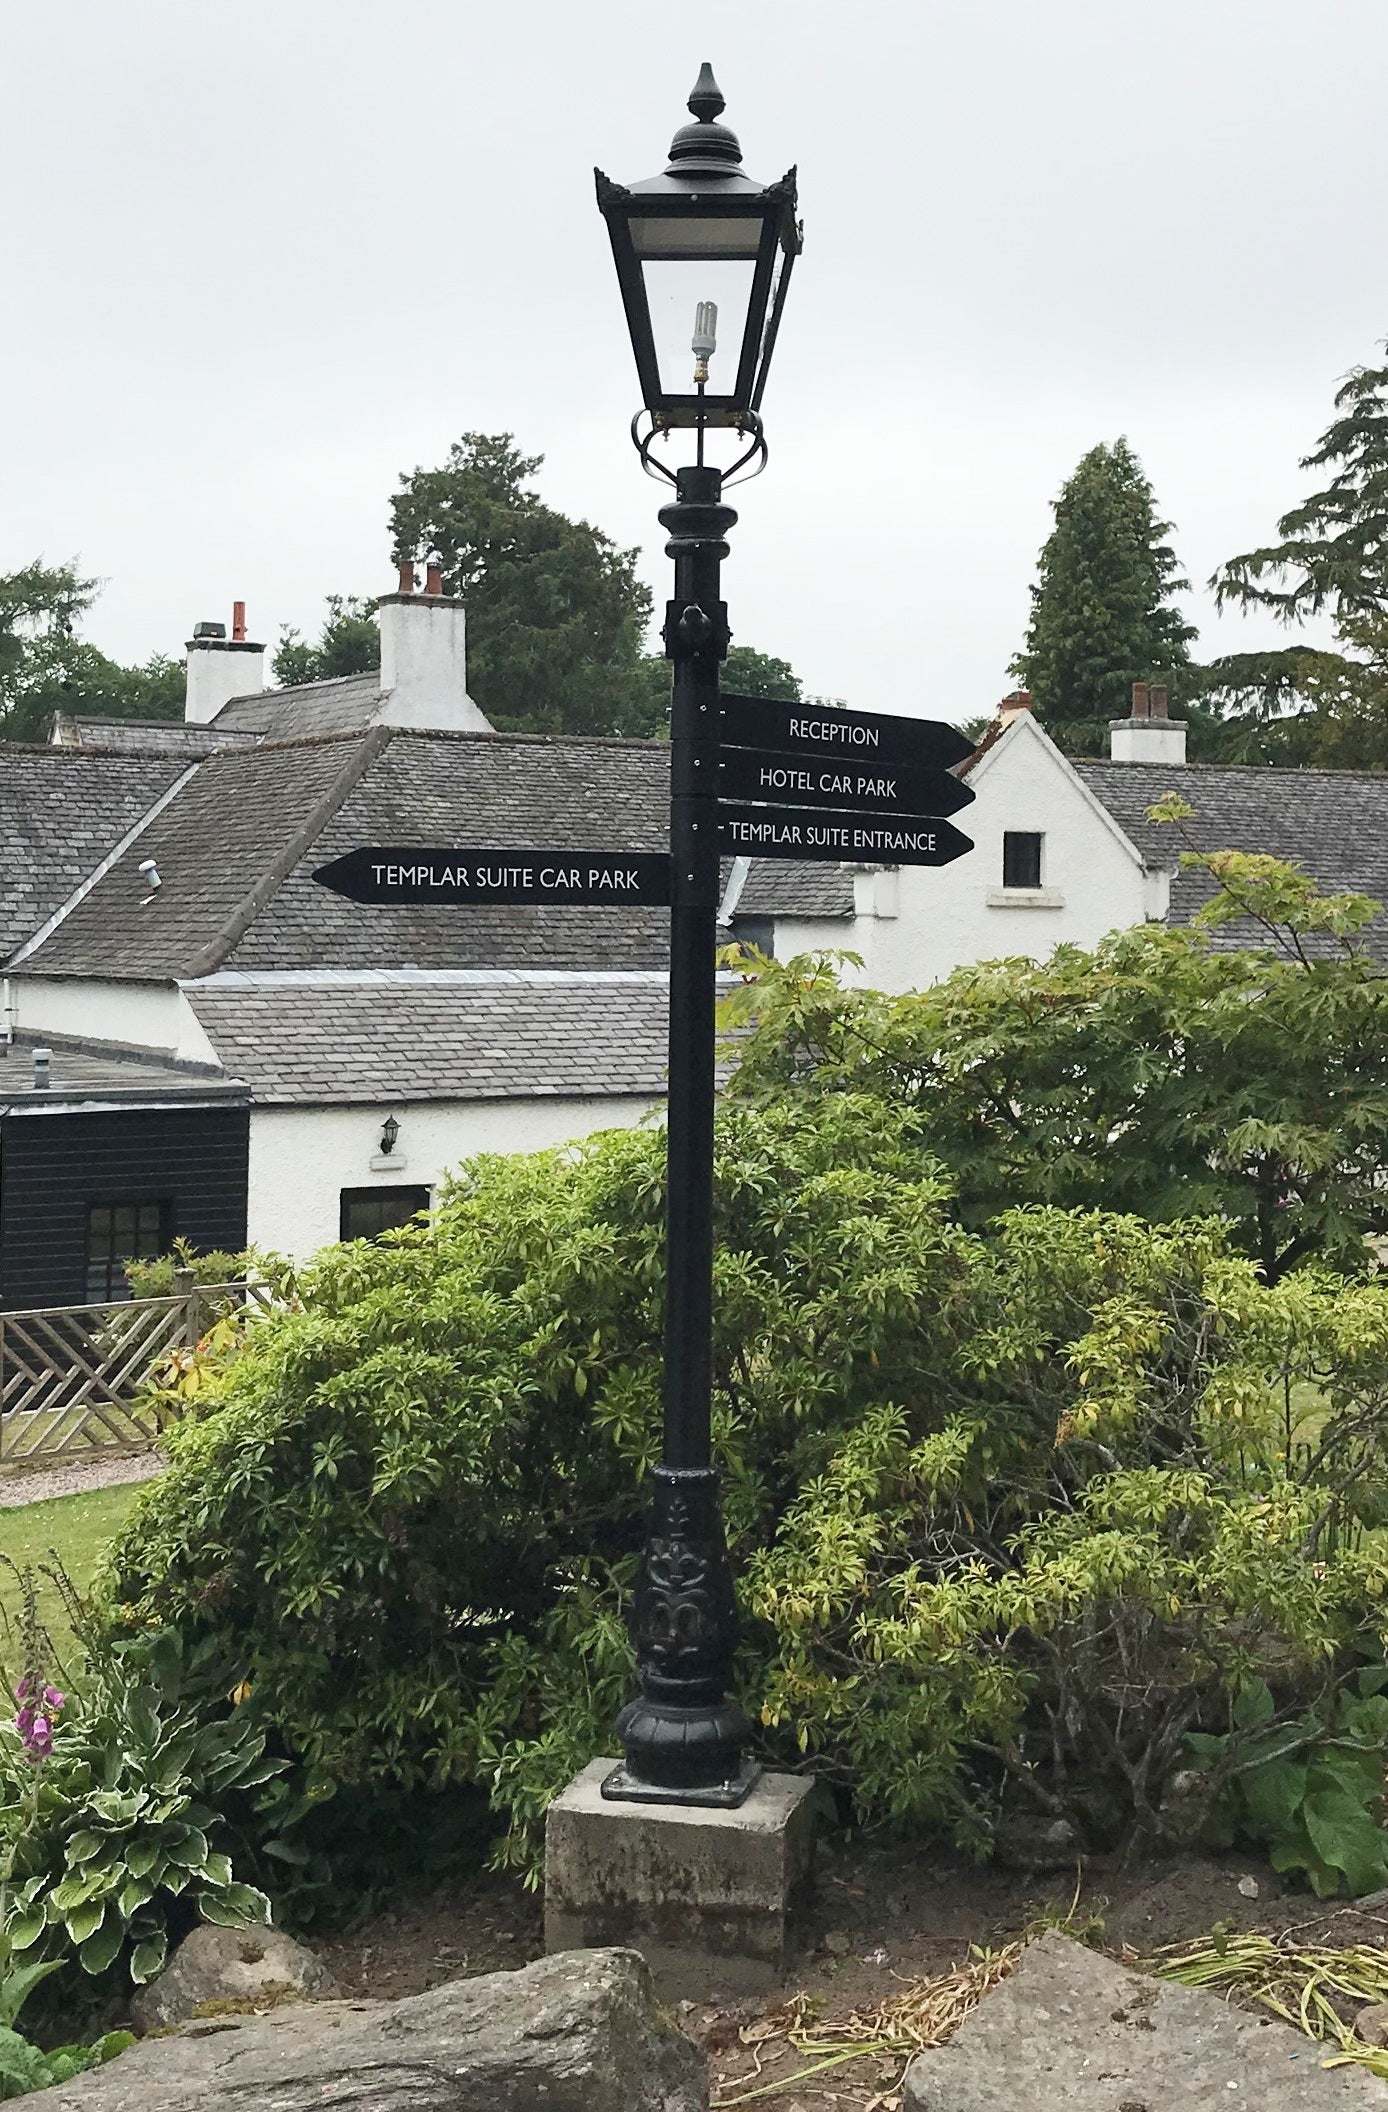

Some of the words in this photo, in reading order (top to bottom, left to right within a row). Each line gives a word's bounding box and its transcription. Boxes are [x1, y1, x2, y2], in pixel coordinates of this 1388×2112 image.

[790, 719, 879, 746] RECEPTION
[760, 768, 814, 790] HOTEL
[820, 774, 853, 794] CAR
[857, 777, 897, 798] PARK
[729, 821, 802, 844] TEMPLAR
[806, 827, 849, 847] SUITE
[853, 830, 937, 851] ENTRANCE
[371, 864, 470, 887] TEMPLAR
[476, 867, 533, 888] SUITE
[539, 868, 583, 888] CAR
[588, 869, 640, 890] PARK
